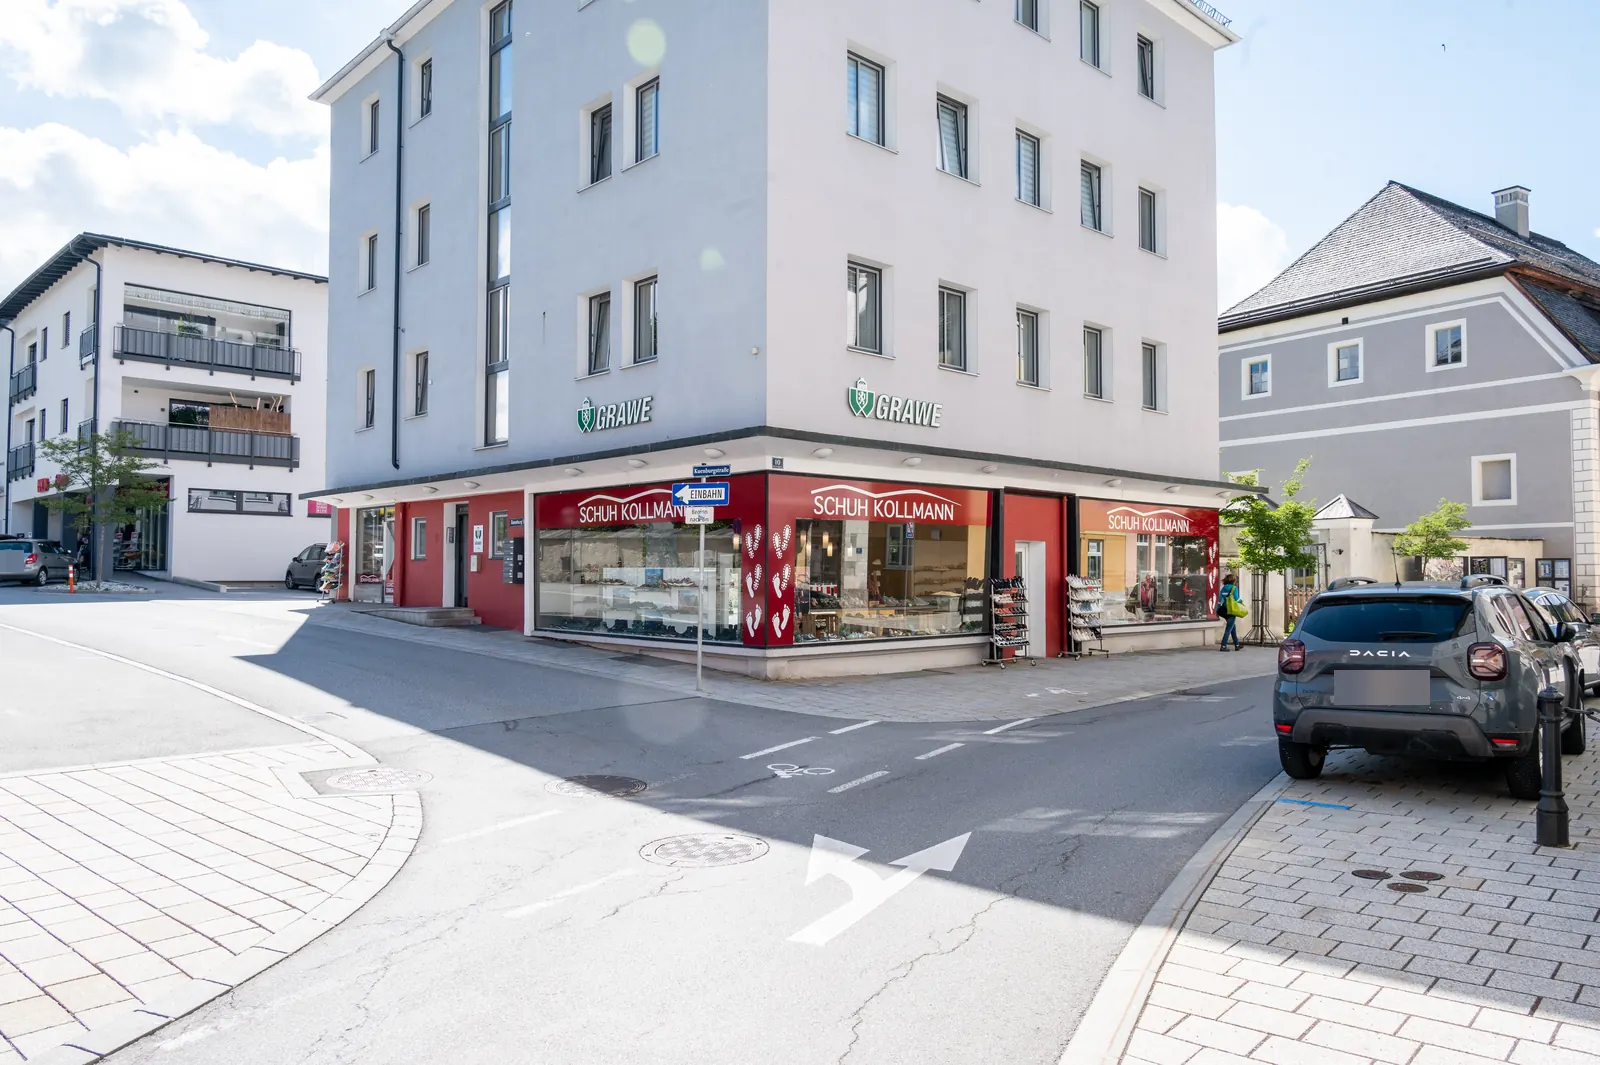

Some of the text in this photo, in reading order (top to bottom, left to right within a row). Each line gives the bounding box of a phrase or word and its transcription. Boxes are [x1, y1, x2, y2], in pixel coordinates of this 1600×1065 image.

[596, 396, 653, 430] GRAWE
[876, 394, 943, 428] GRAWE
[690, 489, 723, 499] EINBAHN
[579, 501, 686, 523] SCHUH KOLLMAN
[813, 495, 955, 521] SCHUH KOLLMANN
[1108, 515, 1190, 532] SCHUH KOLLMANN
